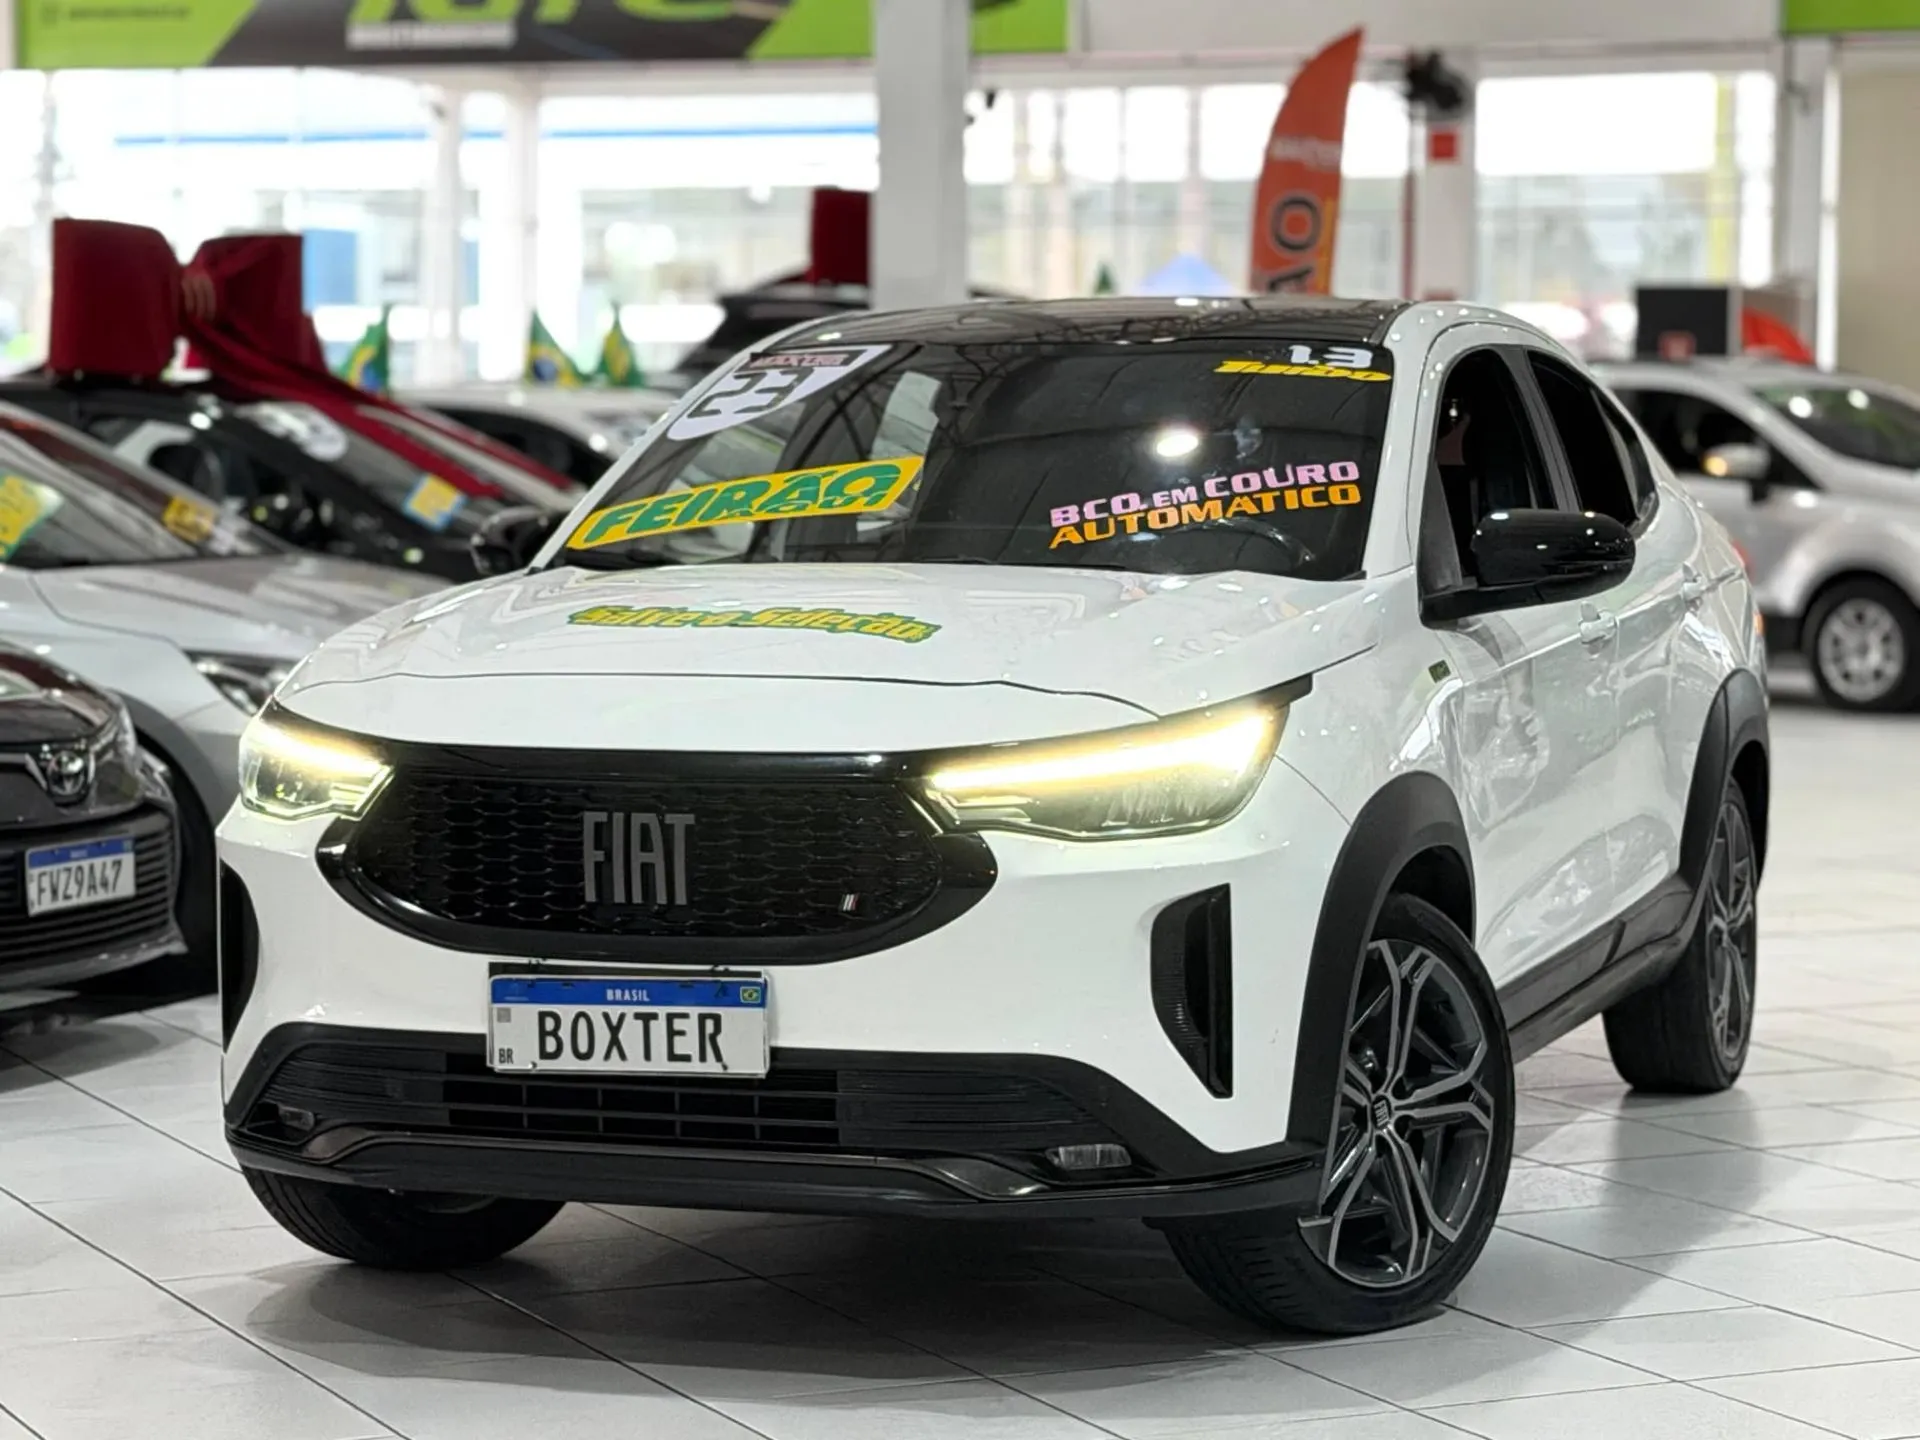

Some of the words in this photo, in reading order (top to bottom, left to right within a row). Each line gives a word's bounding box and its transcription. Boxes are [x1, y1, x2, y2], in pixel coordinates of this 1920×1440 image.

[1288, 344, 1373, 369] 1.3
[1153, 486, 1198, 508] EM
[1204, 460, 1360, 498] COURO
[582, 811, 696, 906] FIAT
[606, 988, 651, 1002] BRASIL
[537, 1010, 724, 1063] BOXTER
[498, 1047, 515, 1065] BR
